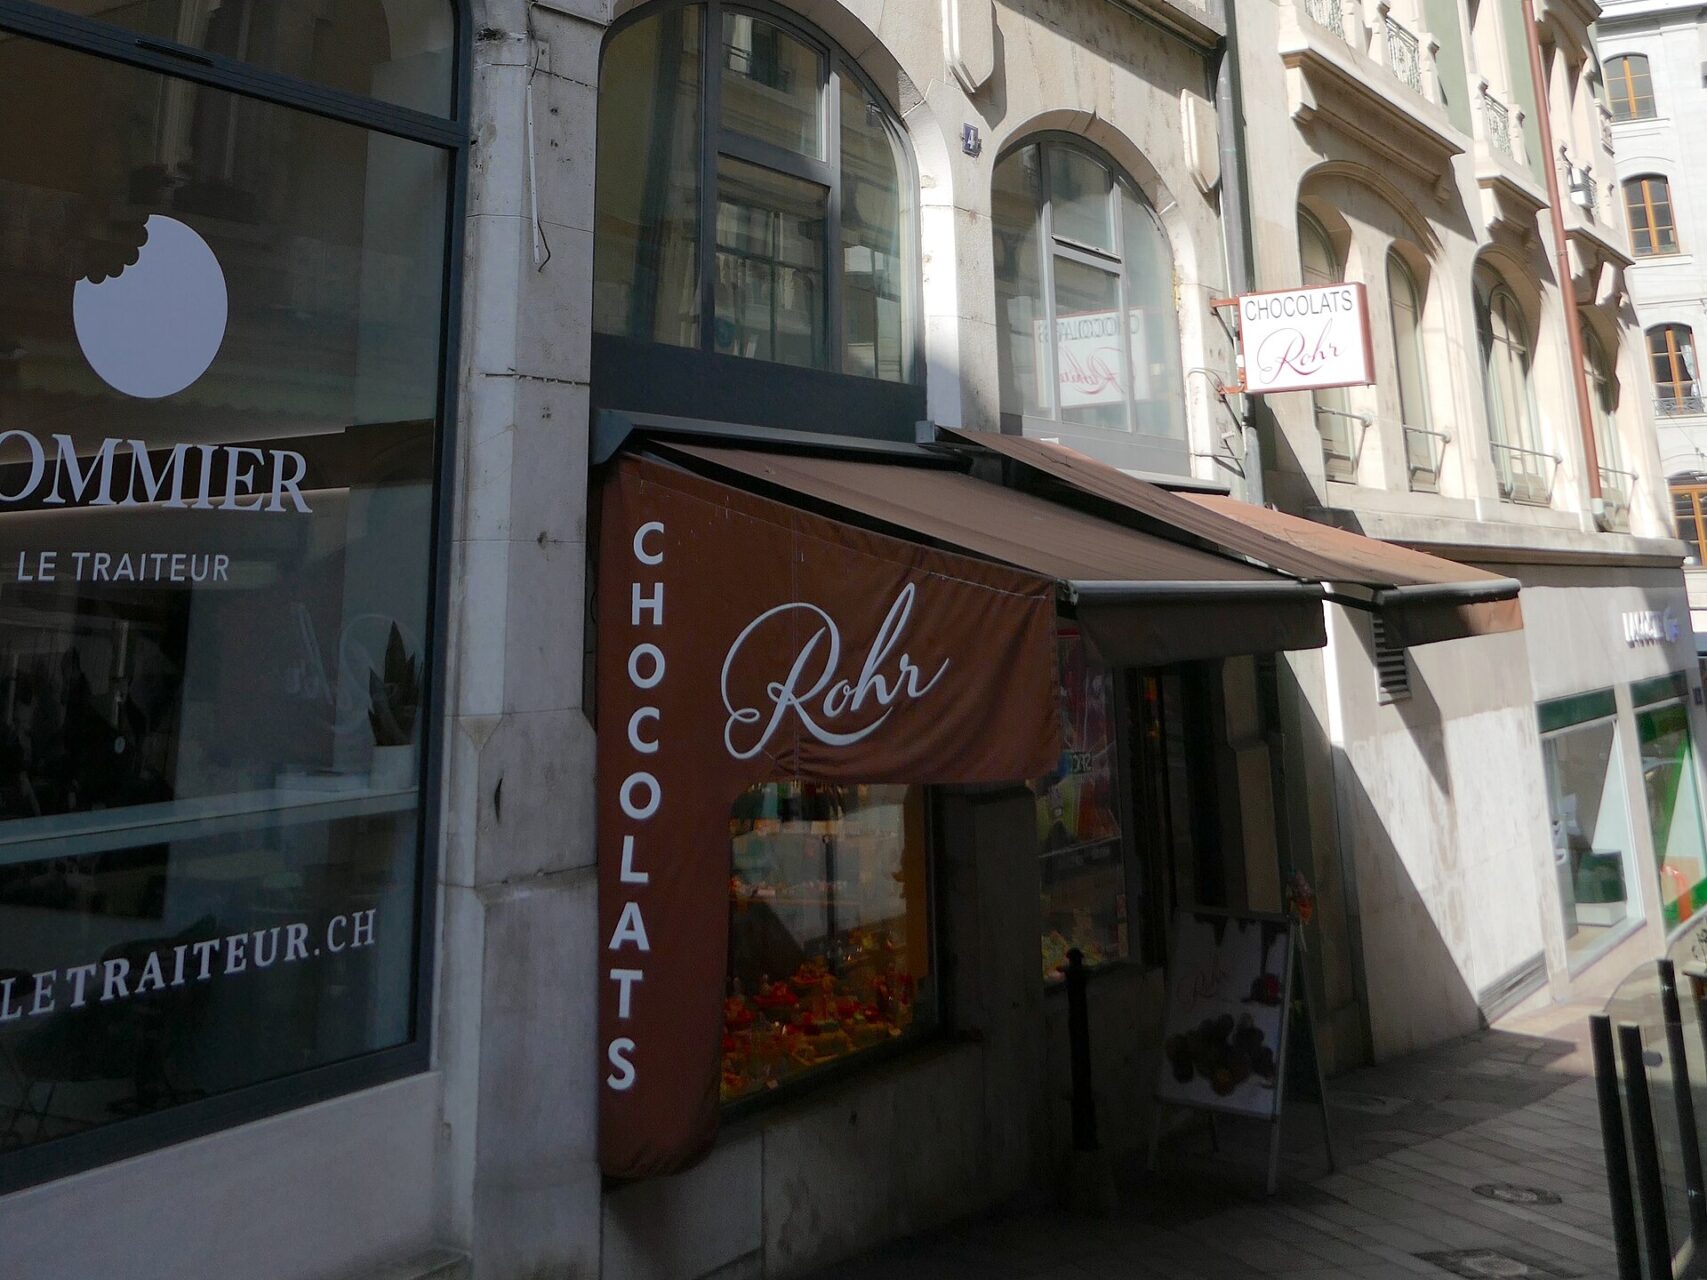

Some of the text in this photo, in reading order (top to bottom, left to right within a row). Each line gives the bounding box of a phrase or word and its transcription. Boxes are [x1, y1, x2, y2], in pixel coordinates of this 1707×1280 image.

[967, 129, 976, 150] 4
[1244, 289, 1353, 322] CHOCOLATS
[1257, 317, 1345, 385] Rohr
[17, 550, 231, 583] LE TRAITEUR
[720, 580, 951, 760] Rohr
[606, 520, 667, 1090] CHOCOLATS
[0, 907, 378, 1022] LETRAITEUR.CH
